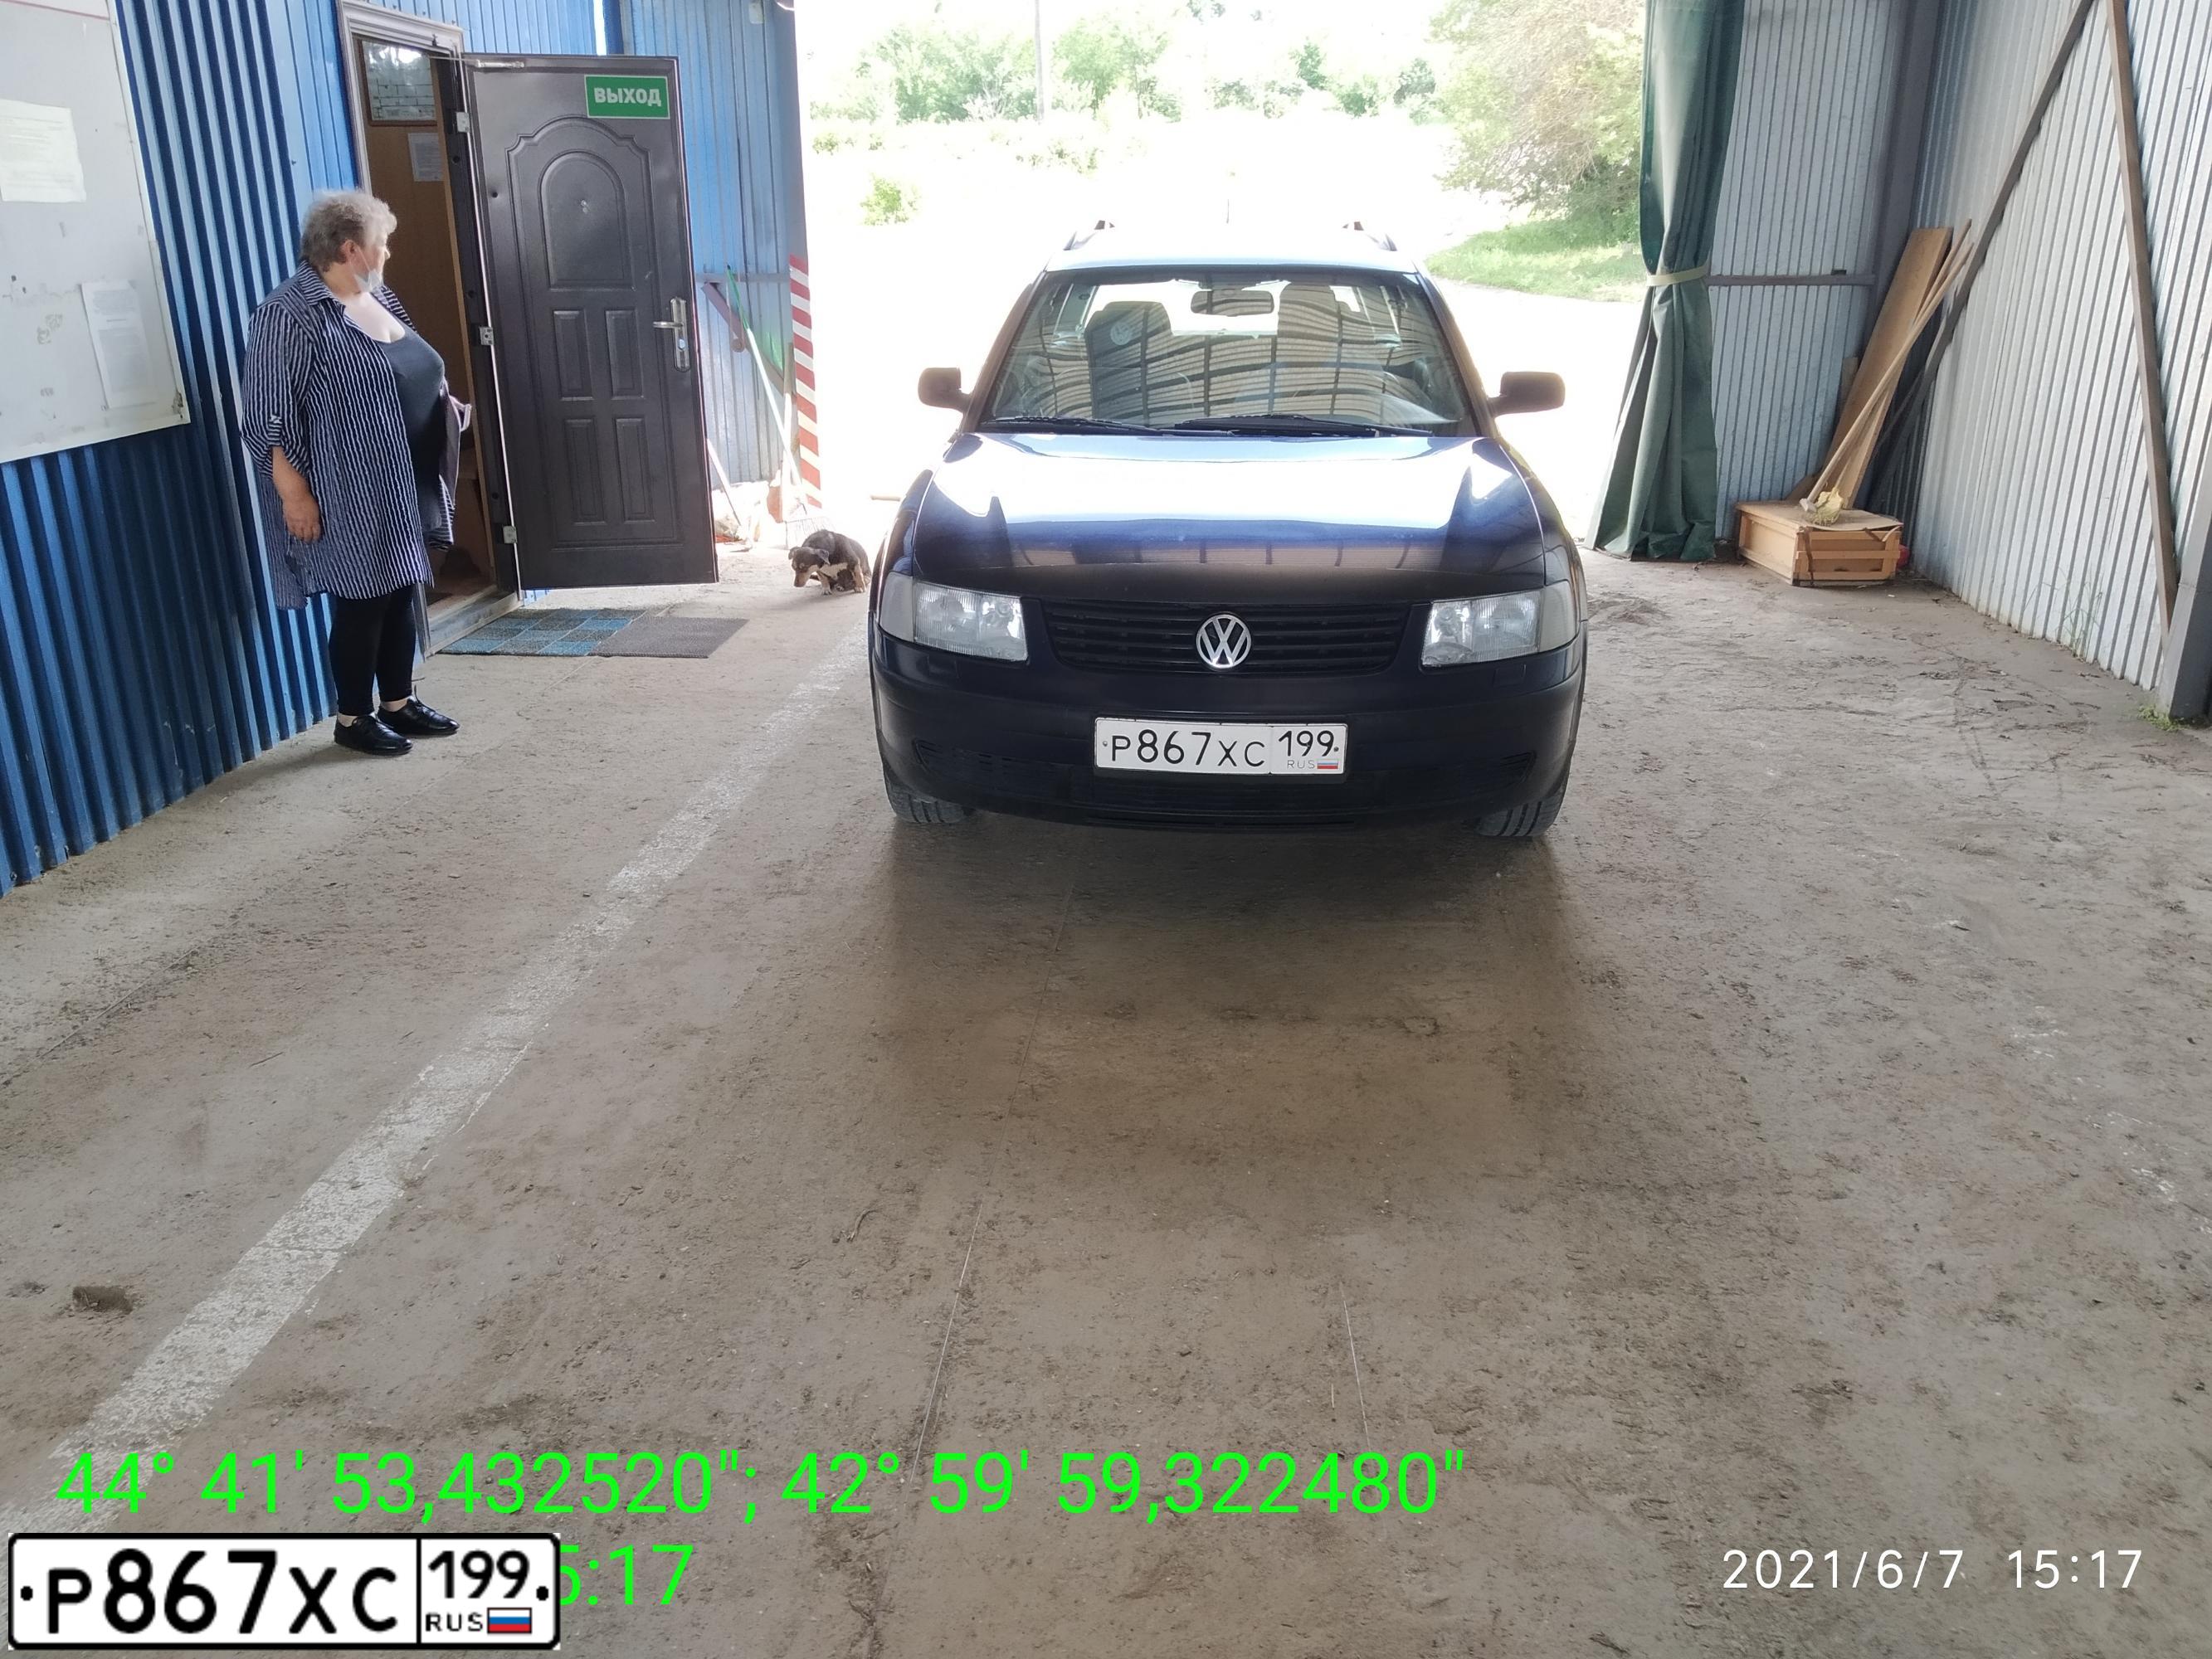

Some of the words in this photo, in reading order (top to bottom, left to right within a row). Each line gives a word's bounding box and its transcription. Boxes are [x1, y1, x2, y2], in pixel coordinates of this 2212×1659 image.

[593, 86, 662, 107] ВЫХОД
[1278, 729, 1335, 757] 199
[1287, 759, 1315, 770] RUS
